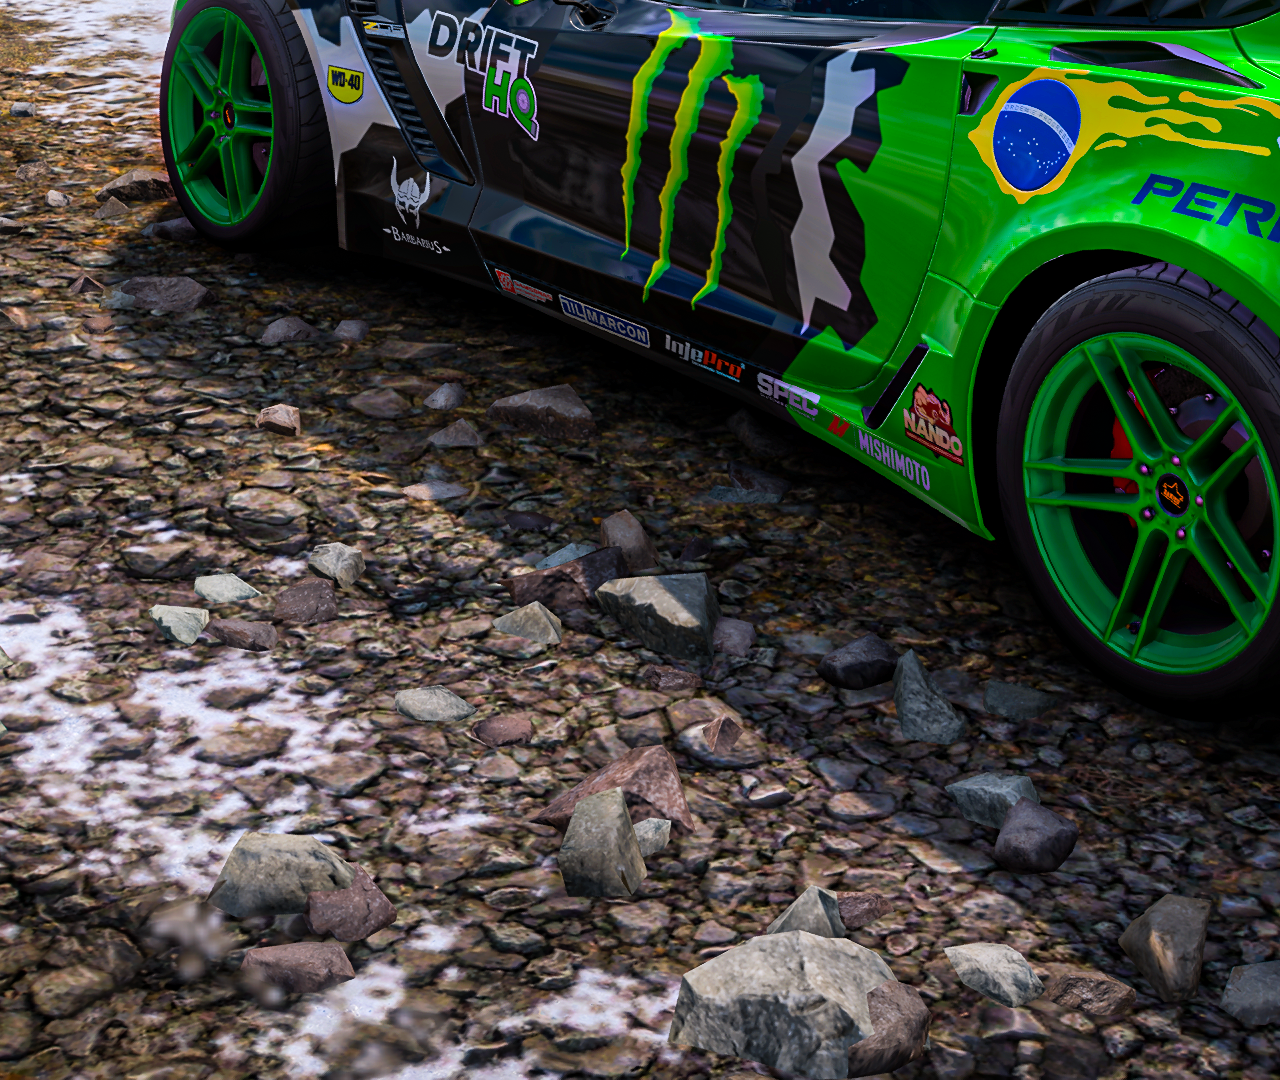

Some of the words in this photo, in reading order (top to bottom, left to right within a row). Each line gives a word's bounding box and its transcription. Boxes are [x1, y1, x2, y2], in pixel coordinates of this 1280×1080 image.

[427, 10, 539, 78] DRIFT
[330, 69, 362, 91] WD-40
[482, 66, 539, 141] HQ
[585, 309, 648, 343] MARCON
[757, 371, 821, 417] SPEC
[902, 407, 964, 458] NANDO
[858, 428, 931, 491] MISHIMOTO
